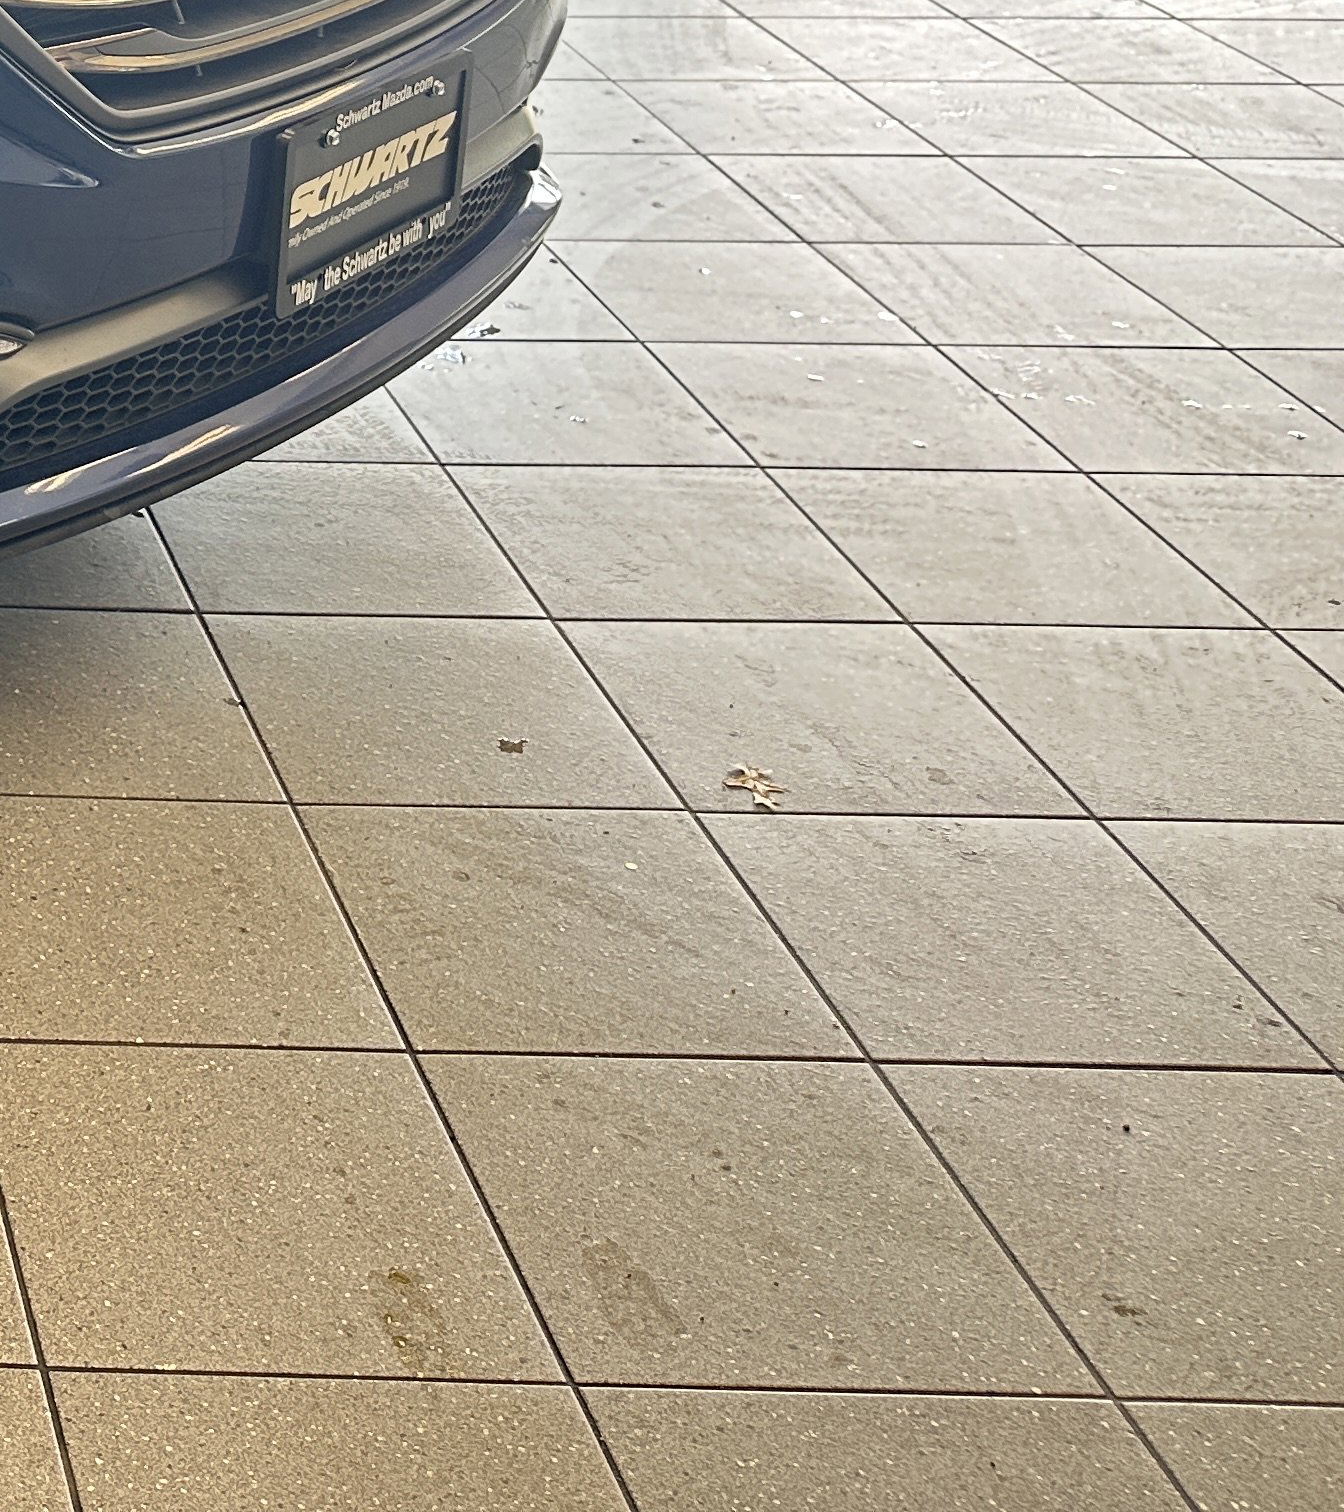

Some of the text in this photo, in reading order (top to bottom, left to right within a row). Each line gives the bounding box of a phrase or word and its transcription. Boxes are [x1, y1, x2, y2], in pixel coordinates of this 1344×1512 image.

[335, 75, 434, 132] Schwartz Mazda.com
[288, 111, 458, 229] SCHWARTZ
[291, 201, 452, 305] "May the Schwartz be with you"
